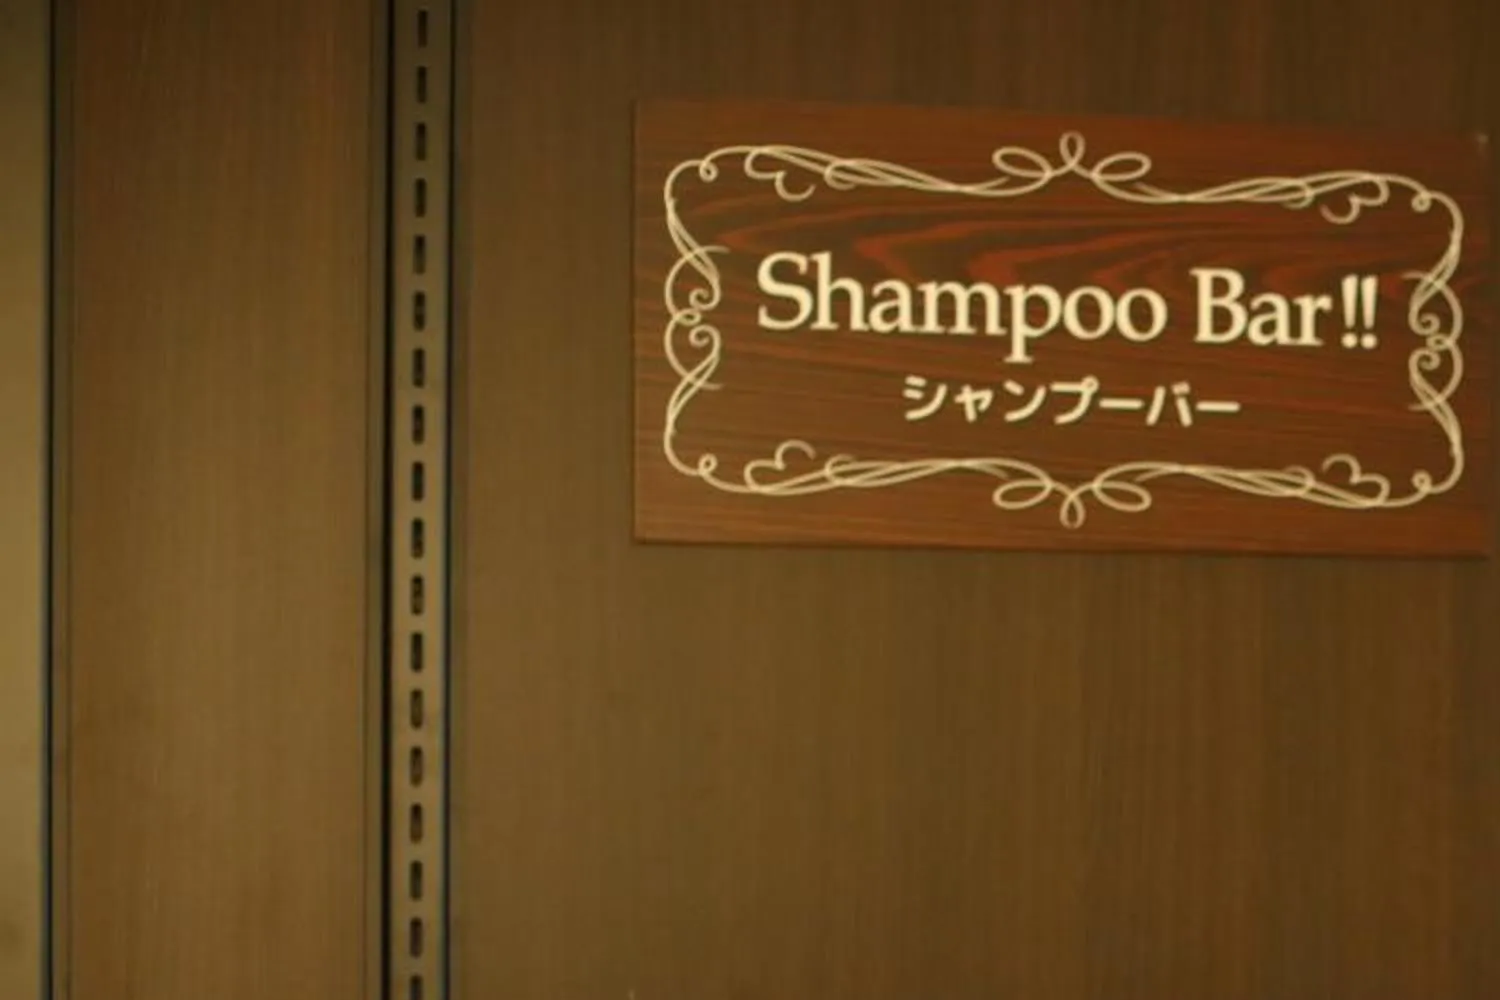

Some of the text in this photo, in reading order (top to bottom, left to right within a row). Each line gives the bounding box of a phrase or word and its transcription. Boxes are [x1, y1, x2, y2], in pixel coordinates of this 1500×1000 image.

[756, 250, 1379, 364] Shampoo Bar!!
[902, 374, 1242, 427] シャンプーバー
